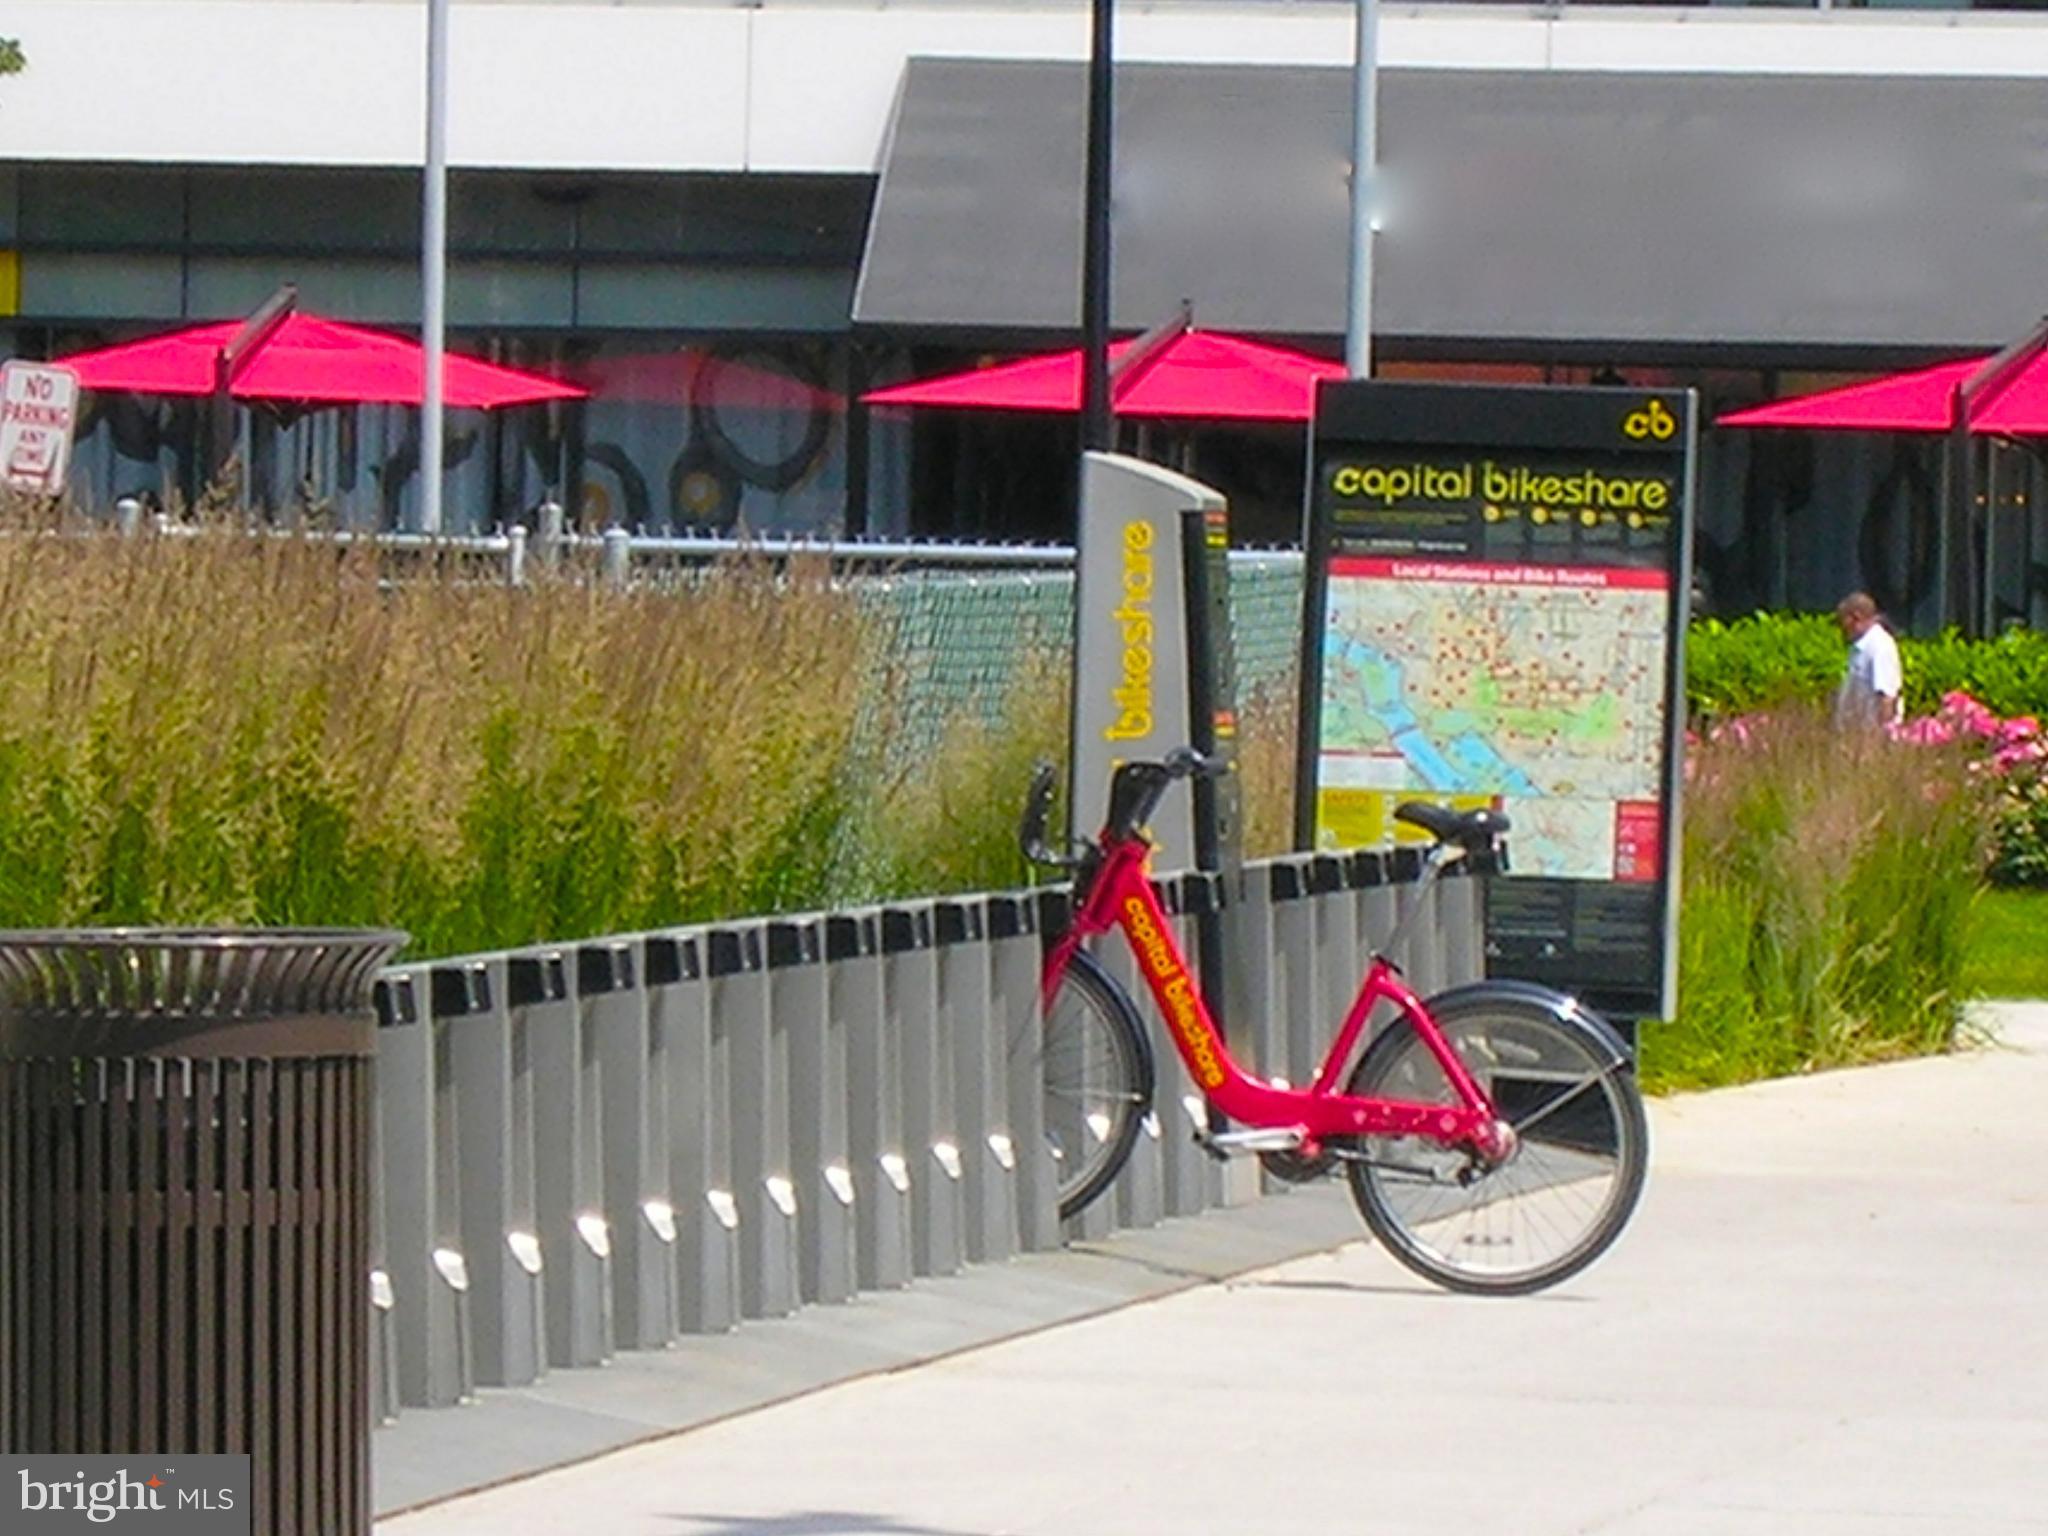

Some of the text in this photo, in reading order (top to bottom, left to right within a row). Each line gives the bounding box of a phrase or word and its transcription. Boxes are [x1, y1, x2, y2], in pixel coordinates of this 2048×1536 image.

[24, 374, 53, 400] NO
[2, 401, 70, 430] PARKING
[1333, 461, 1667, 509] capital bikeshare
[1391, 561, 1432, 577] Local
[1434, 562, 1491, 580] Stations
[1494, 564, 1521, 581] and
[1523, 565, 1554, 582] Bike
[1105, 519, 1154, 740] bikeshare
[1163, 975, 1225, 1088] bikeshare
